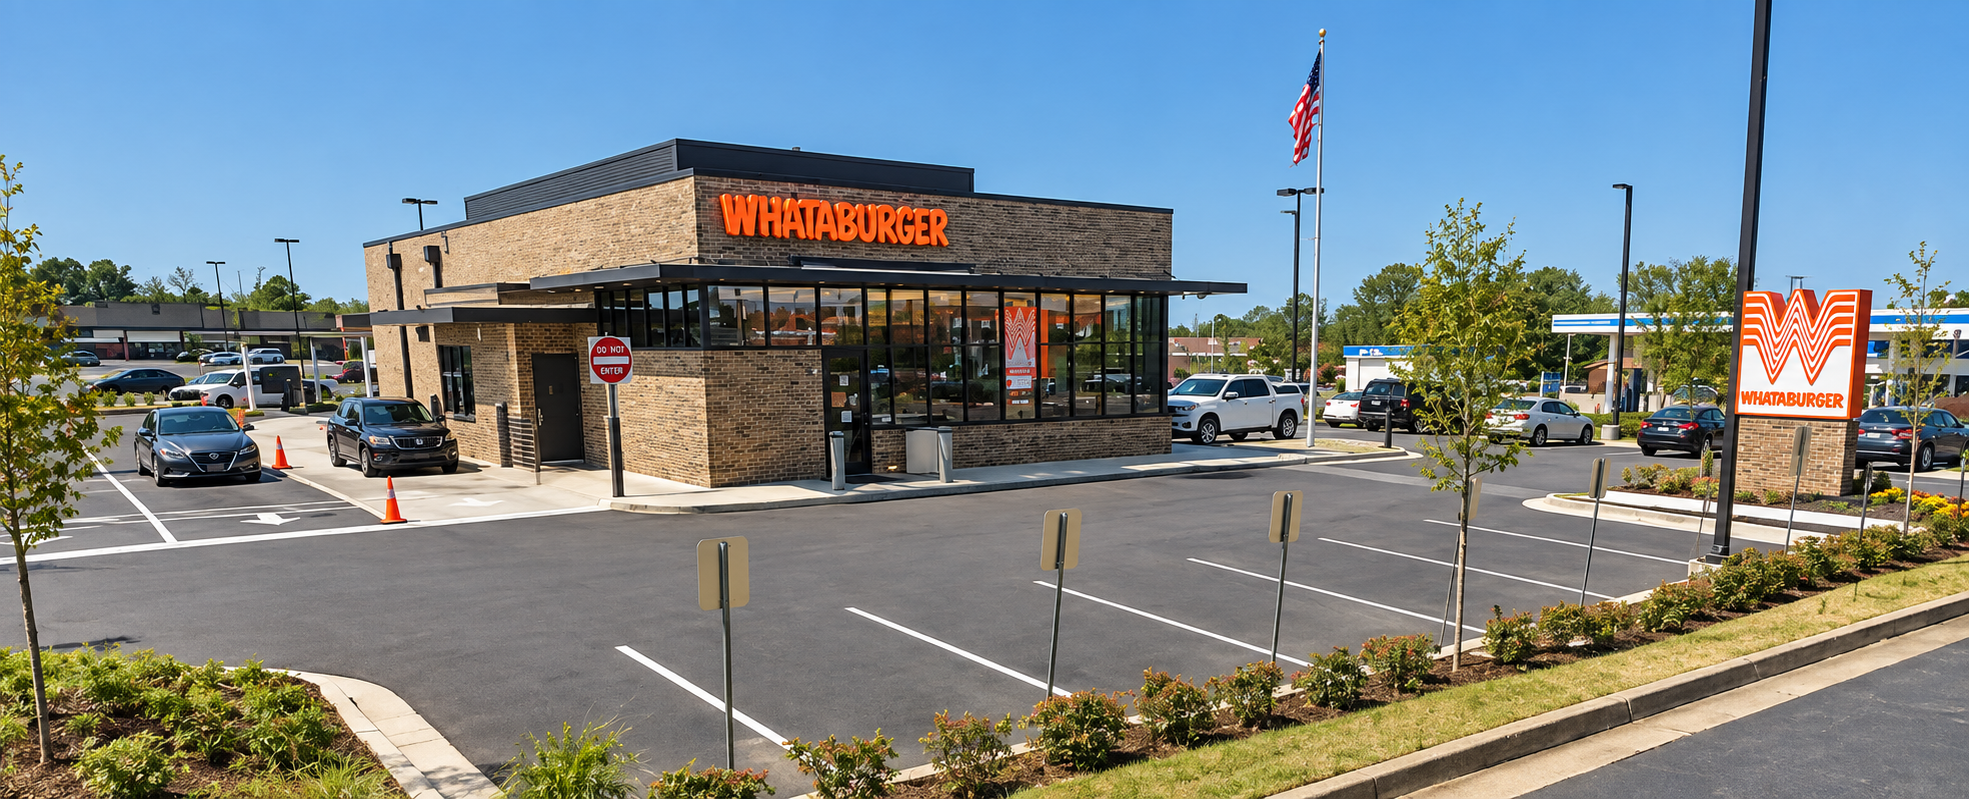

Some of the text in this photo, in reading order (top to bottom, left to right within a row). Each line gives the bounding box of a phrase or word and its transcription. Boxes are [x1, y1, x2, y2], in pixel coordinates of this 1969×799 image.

[719, 193, 949, 247] WHATABURGER
[596, 346, 607, 354] DO
[600, 367, 623, 375] ENTER
[1741, 390, 1844, 409] WHATABURGER
